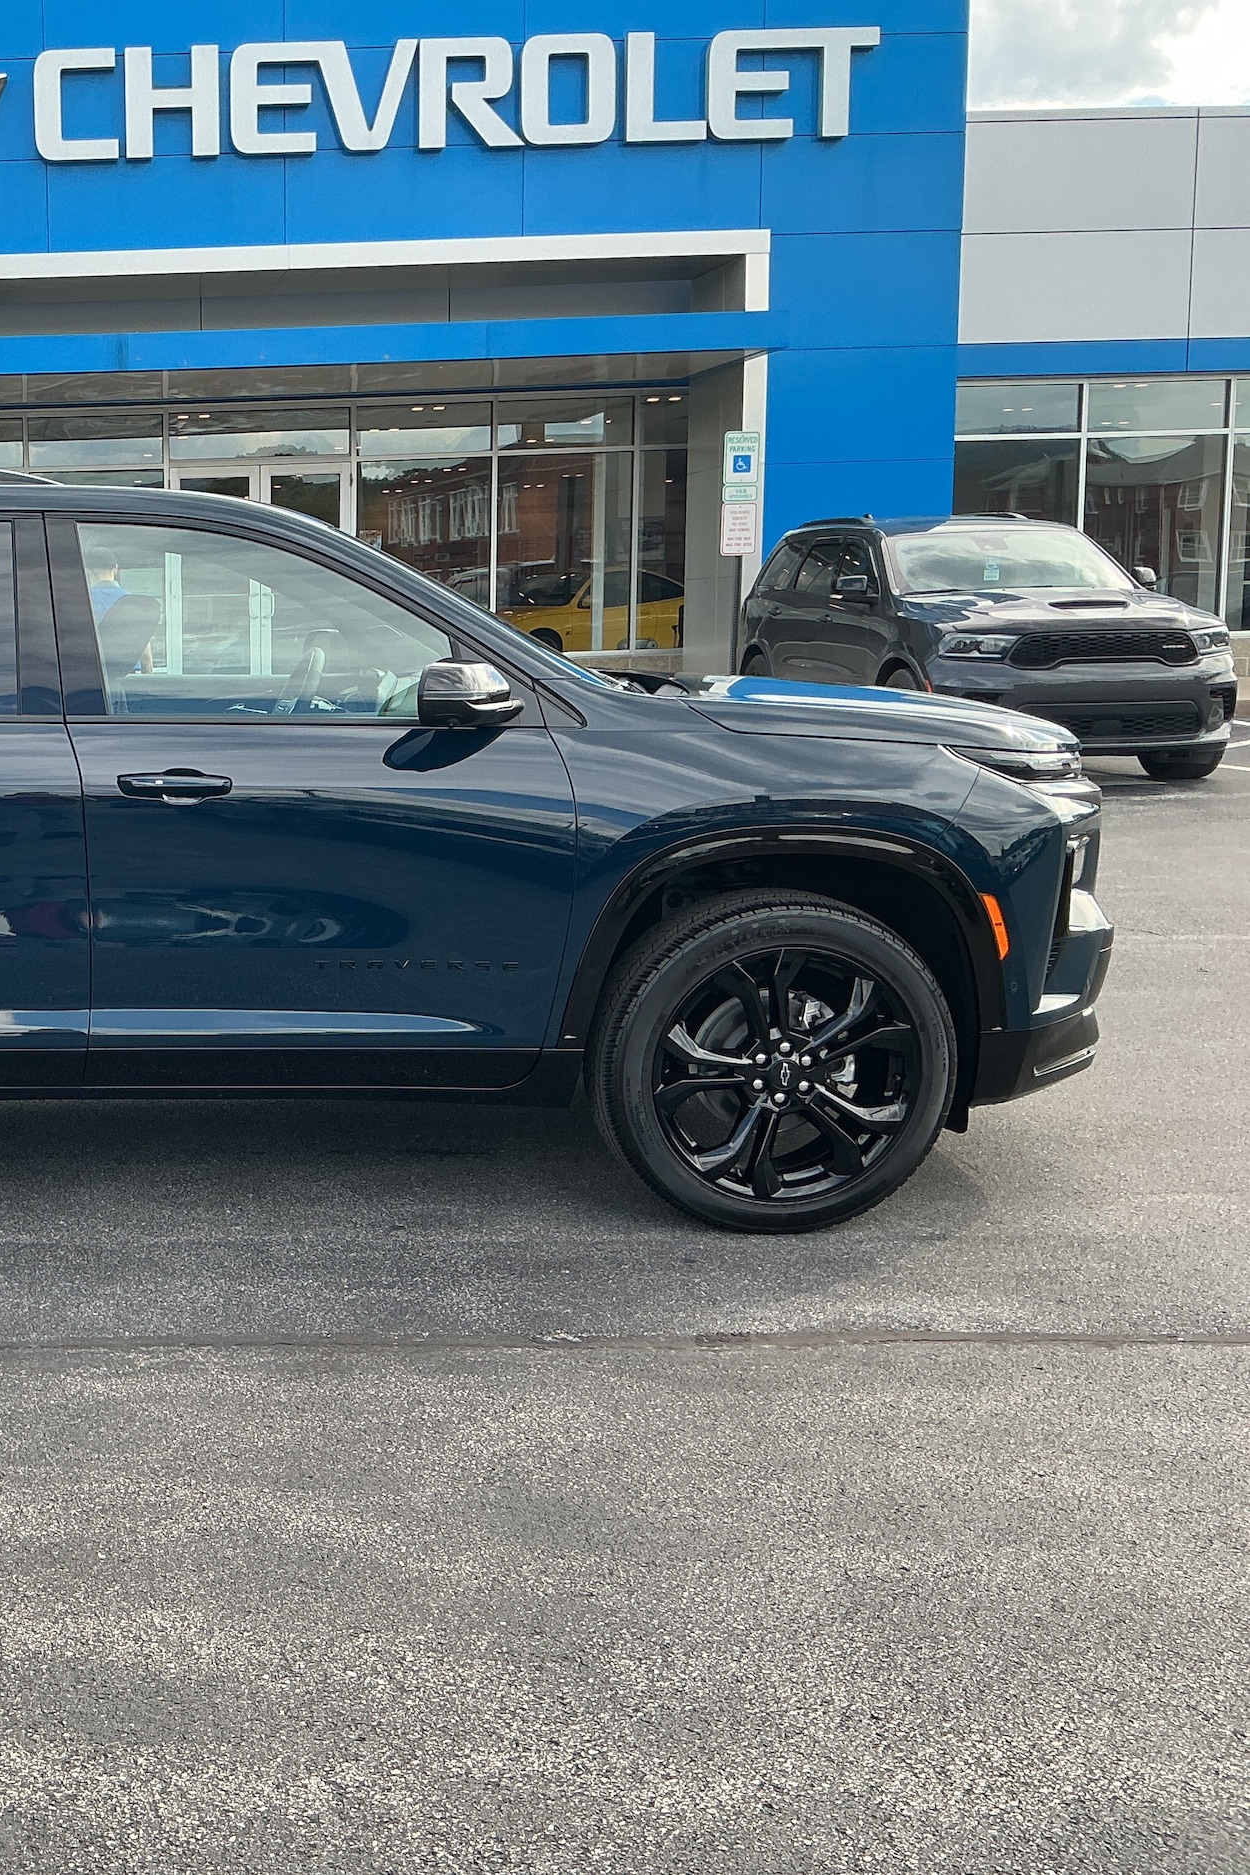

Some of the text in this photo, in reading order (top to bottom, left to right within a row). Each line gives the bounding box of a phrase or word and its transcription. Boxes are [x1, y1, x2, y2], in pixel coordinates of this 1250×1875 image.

[34, 27, 881, 161] CHEVROLET
[728, 436, 758, 444] RESERVED
[729, 445, 756, 453] PARKING
[313, 959, 520, 971] TRAVERSE
